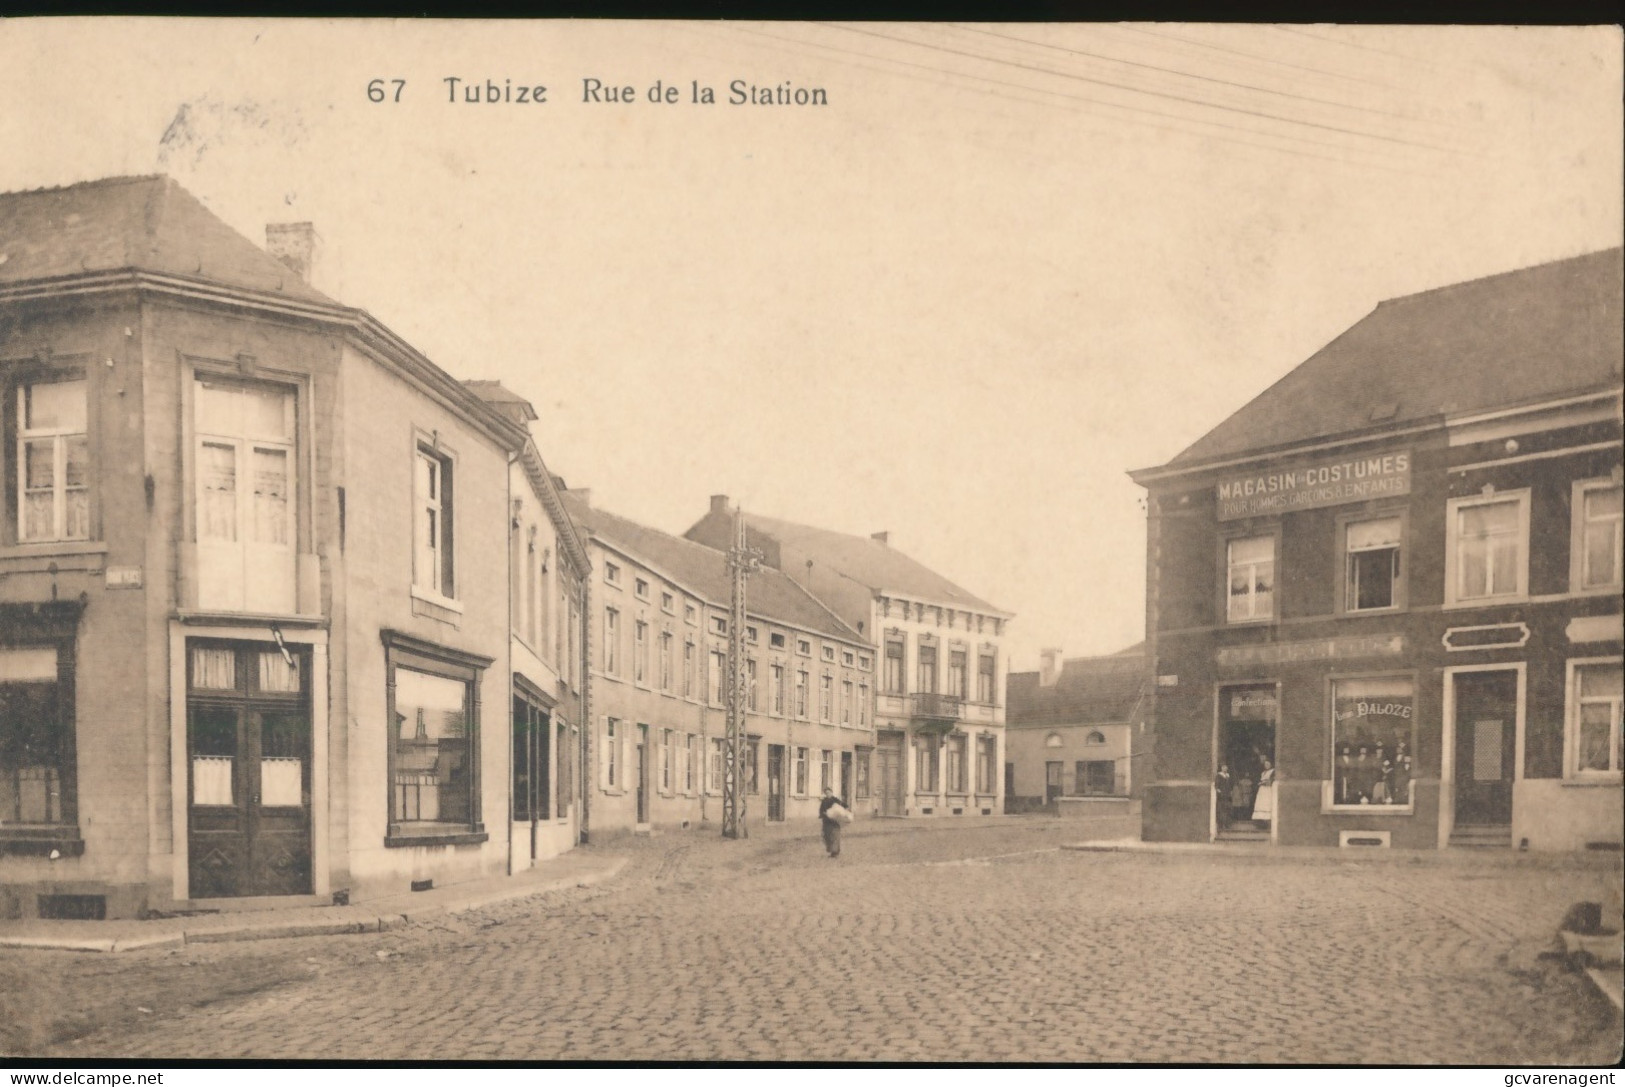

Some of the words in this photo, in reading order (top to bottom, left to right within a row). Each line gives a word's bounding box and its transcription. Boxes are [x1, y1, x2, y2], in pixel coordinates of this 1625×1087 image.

[1219, 472, 1296, 500] MAGASIN
[1306, 454, 1409, 486] COSTUMES
[1224, 501, 1248, 515] POUR
[1345, 476, 1404, 497] ENFANTS
